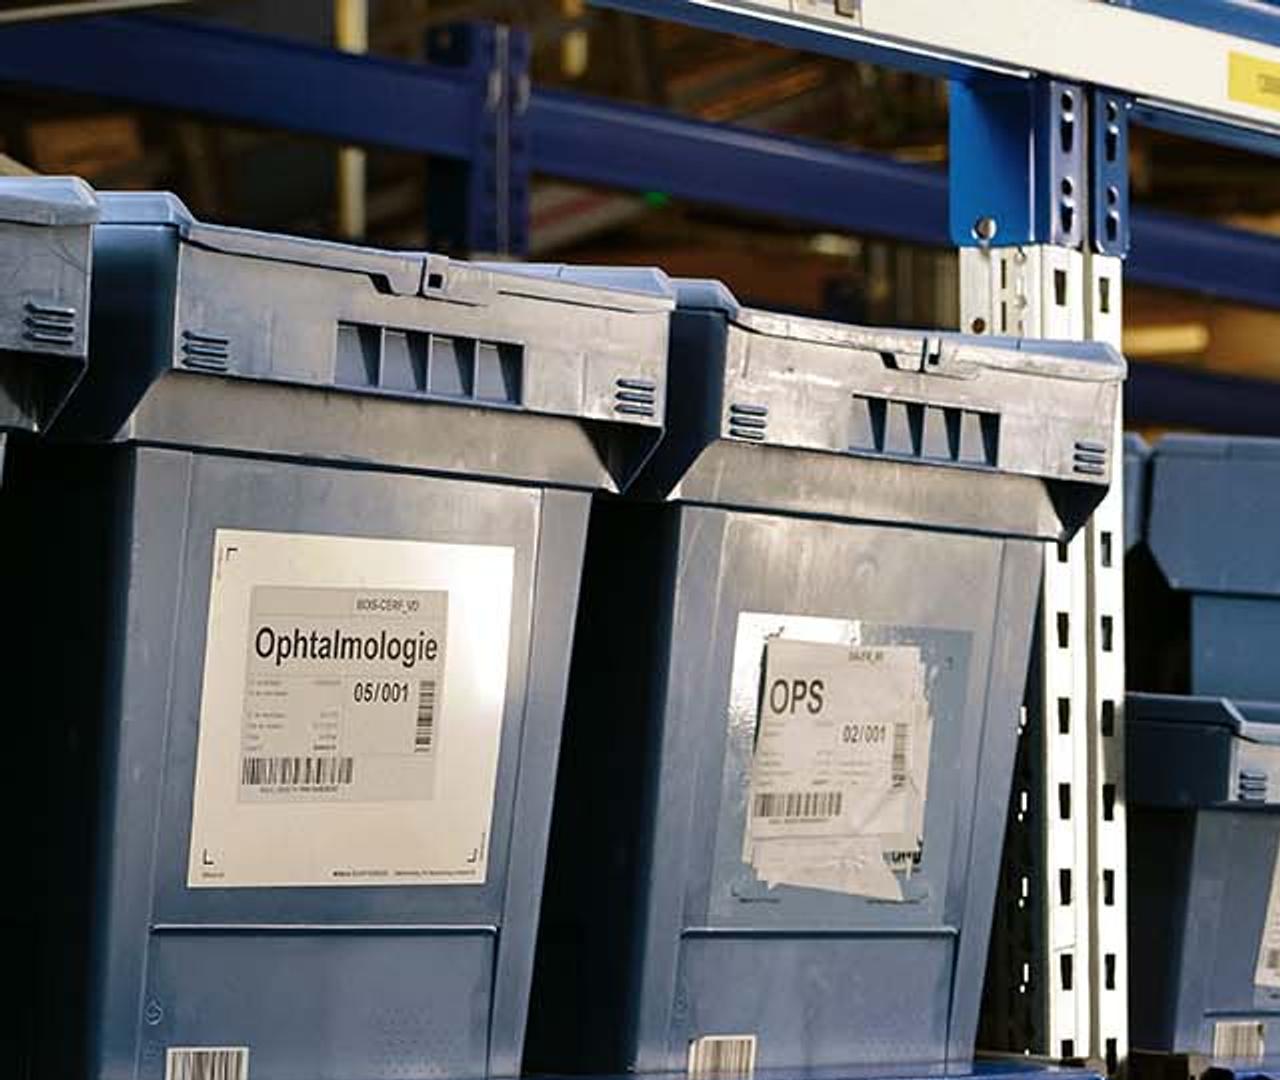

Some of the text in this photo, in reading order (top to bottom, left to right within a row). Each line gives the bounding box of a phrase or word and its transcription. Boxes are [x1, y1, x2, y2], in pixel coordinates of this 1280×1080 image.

[254, 626, 438, 669] Ophtalmologie
[353, 681, 409, 703] 05/001
[769, 678, 825, 715] OPS
